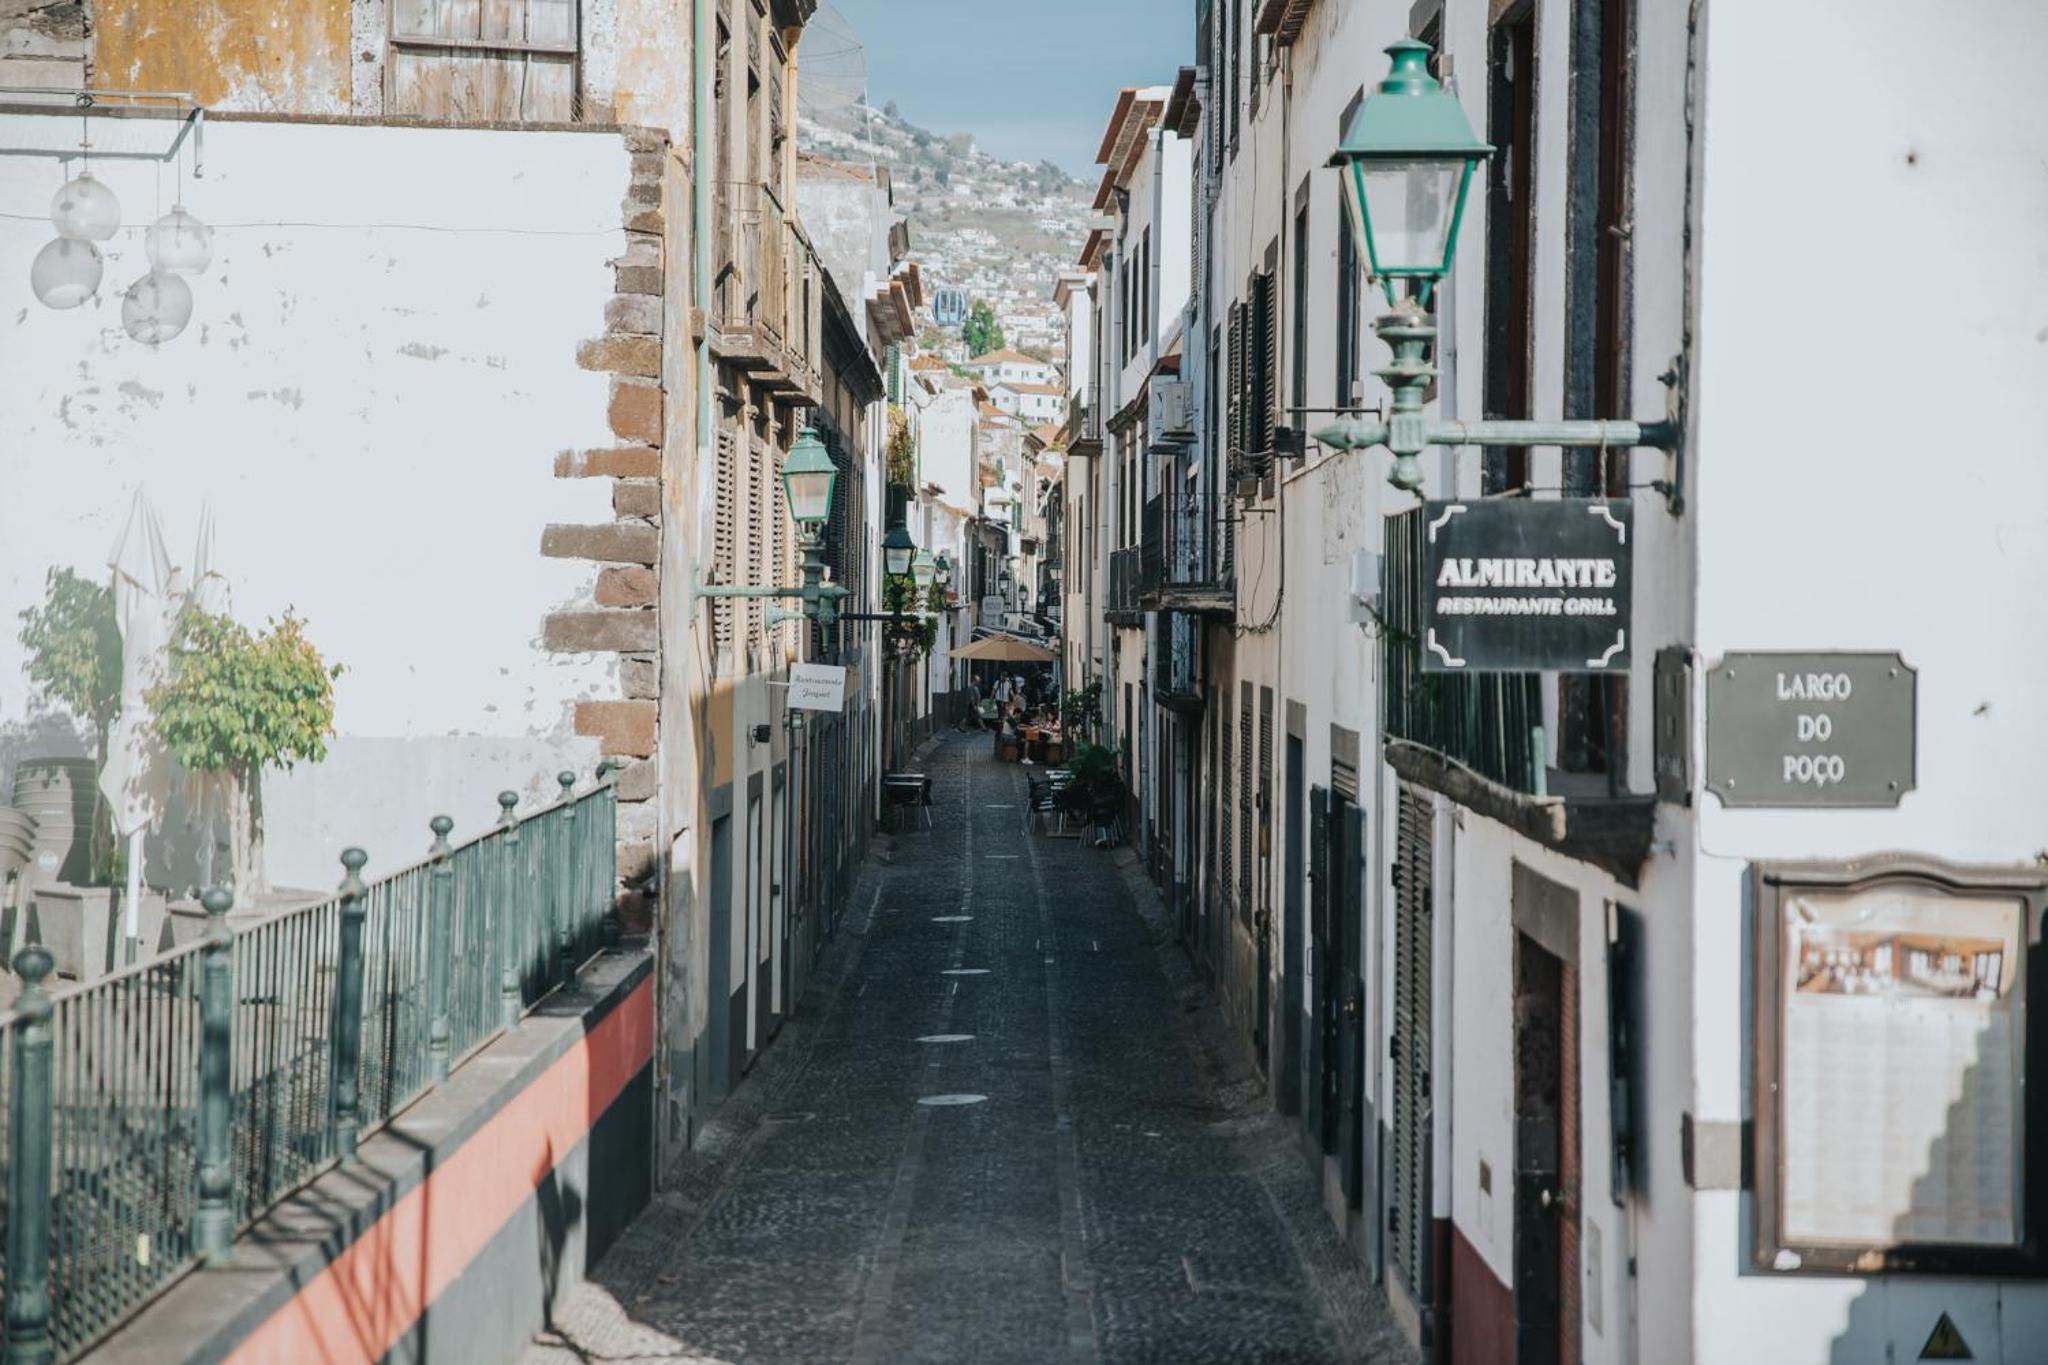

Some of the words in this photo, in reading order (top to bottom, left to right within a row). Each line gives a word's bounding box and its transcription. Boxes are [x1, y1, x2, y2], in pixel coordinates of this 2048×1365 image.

[1437, 557, 1617, 588] ALMIRANTE
[1436, 597, 1563, 615] RESTAURANTE
[1563, 597, 1617, 615] GRILL
[1776, 672, 1852, 701] LARGO
[1797, 714, 1832, 742] DO
[1784, 755, 1845, 788] POÇO
